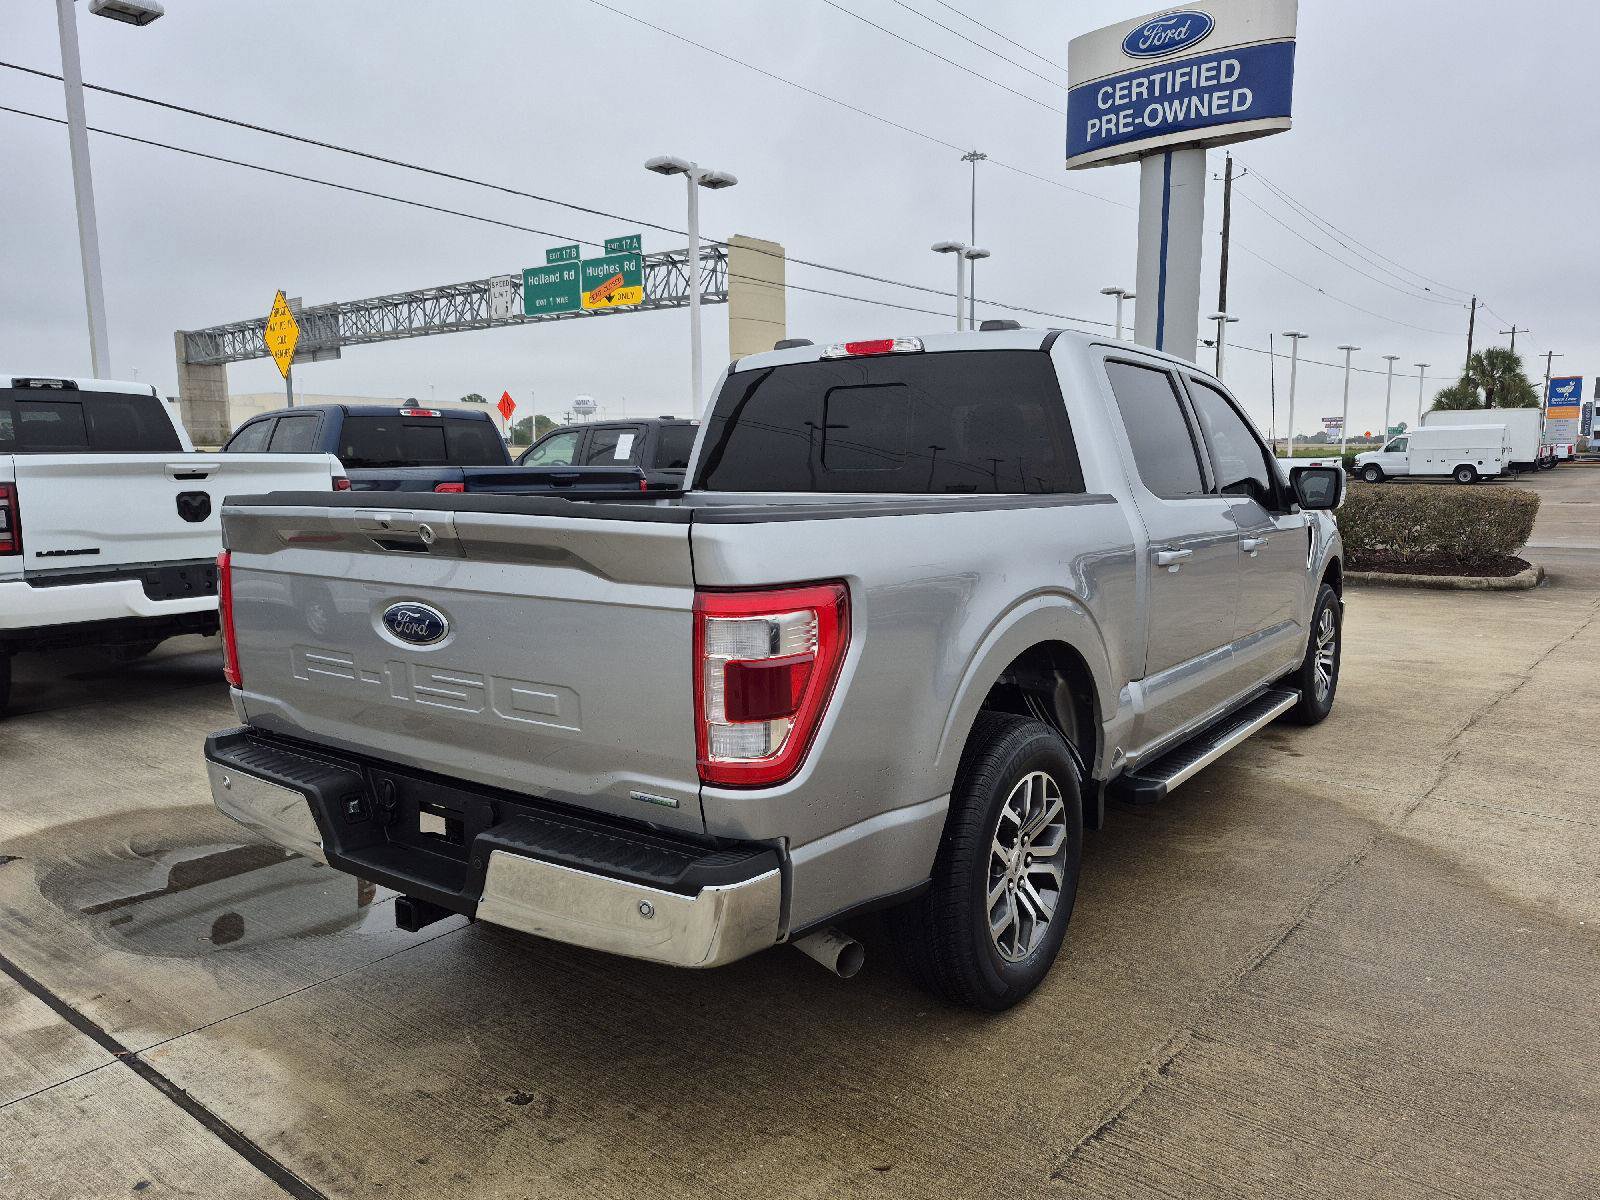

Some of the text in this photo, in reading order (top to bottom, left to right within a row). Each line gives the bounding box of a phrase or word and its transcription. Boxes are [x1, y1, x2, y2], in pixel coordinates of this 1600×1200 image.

[1138, 18, 1192, 50] Ford
[1097, 58, 1241, 110] CERTIFIED
[1086, 87, 1253, 142] PRE-OWNED
[549, 252, 561, 260] EXIT
[528, 269, 575, 286] Holland Rd
[586, 260, 636, 278] Hughes Rd
[491, 280, 510, 289] SPEED
[617, 291, 635, 301] ONLY
[394, 610, 430, 636] Ford
[290, 644, 583, 732] F-150
